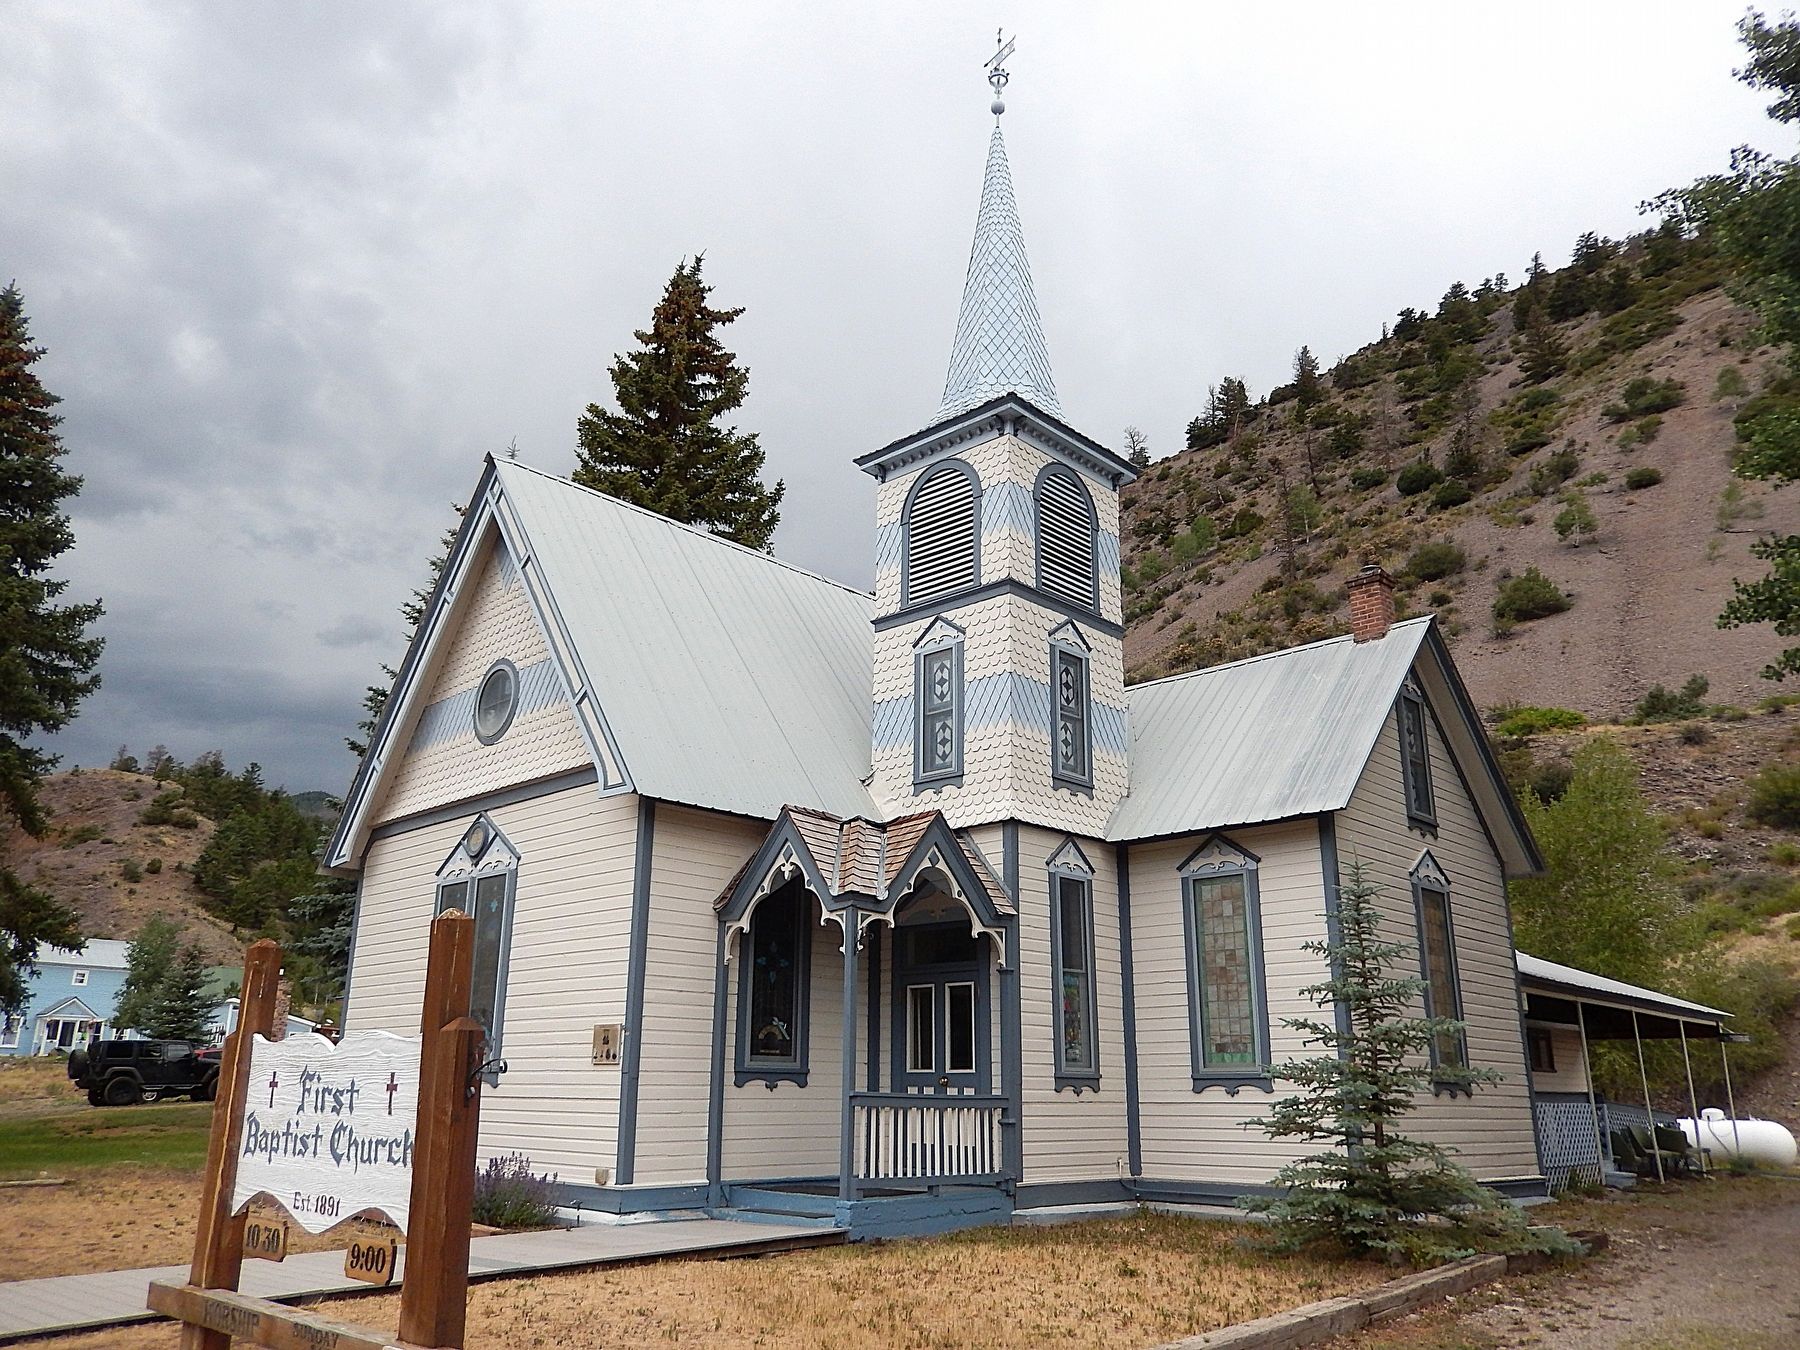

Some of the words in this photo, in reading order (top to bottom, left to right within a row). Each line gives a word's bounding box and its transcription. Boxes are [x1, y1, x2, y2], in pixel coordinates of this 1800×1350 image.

[296, 1064, 360, 1117] First
[243, 1110, 323, 1165] Baptist
[329, 1119, 414, 1175] Church
[293, 1191, 312, 1213] Est.
[313, 1194, 341, 1217] 1891
[349, 1243, 387, 1274] 9:00
